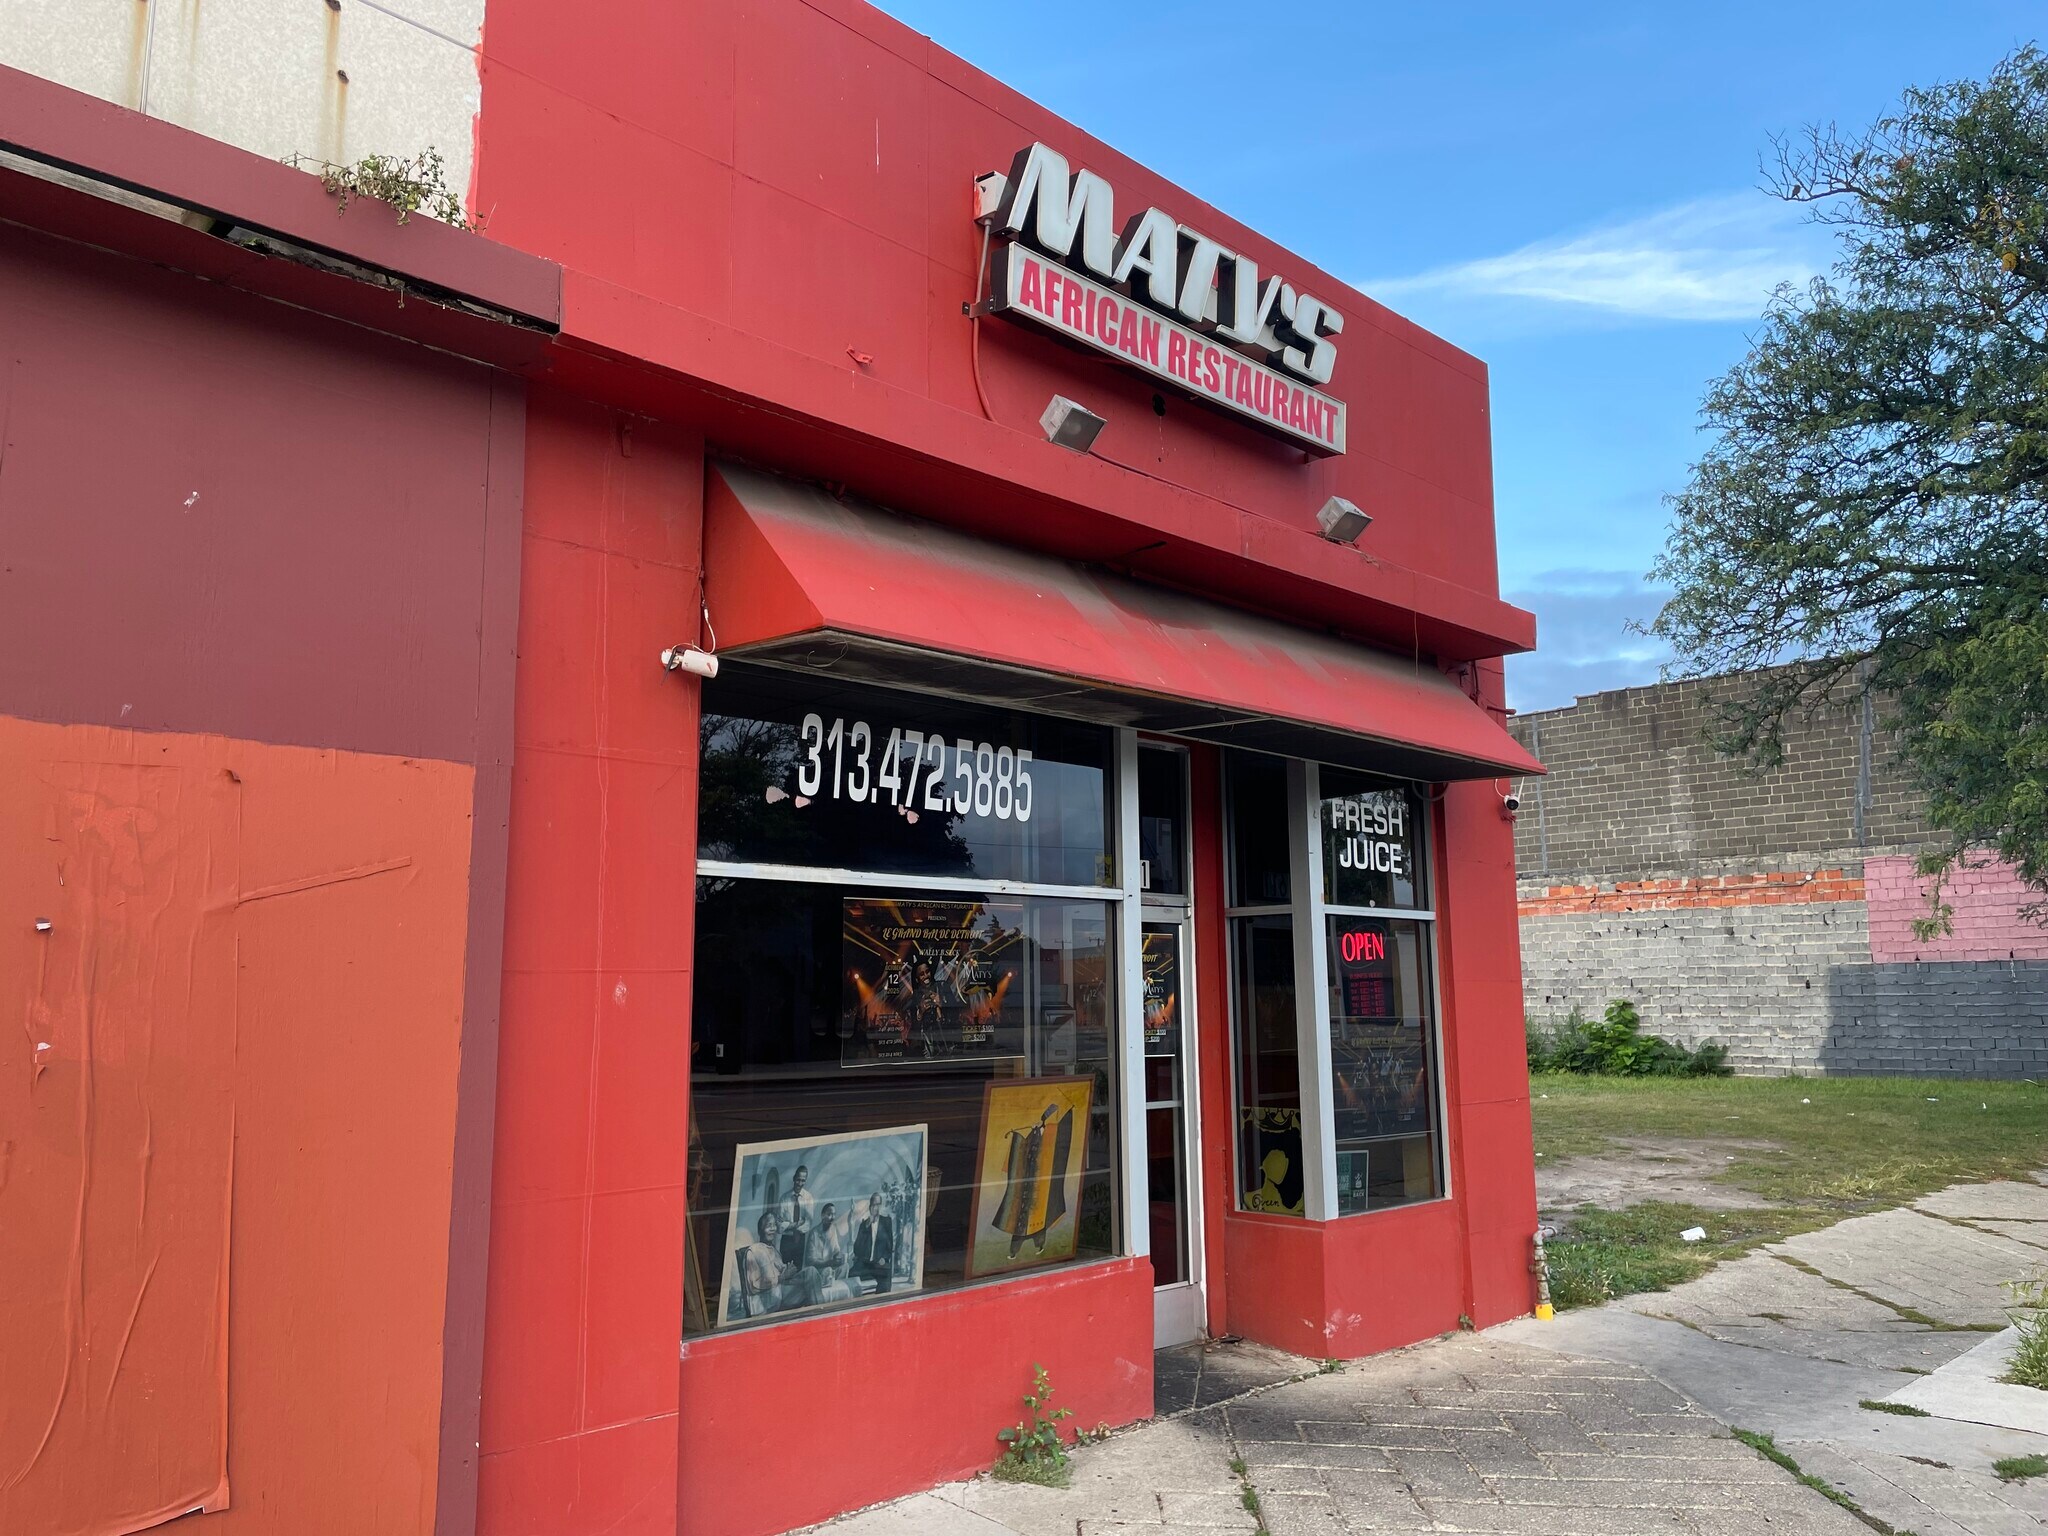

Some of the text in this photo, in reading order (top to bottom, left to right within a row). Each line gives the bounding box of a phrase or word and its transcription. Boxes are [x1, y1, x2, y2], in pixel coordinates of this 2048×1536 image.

[1004, 141, 1344, 385] MATY'S
[1019, 258, 1339, 444] AFRICAN RESTAURANT
[798, 713, 1033, 823] 313.472.5885
[1331, 799, 1404, 837] FRESH
[1339, 837, 1403, 874] JUICE
[891, 927, 922, 940] GRAND
[922, 928, 940, 942] BAL
[939, 928, 950, 939] DE
[950, 929, 984, 940] DETROIT
[1341, 932, 1384, 962] OPEN
[888, 973, 899, 984] 12
[962, 966, 992, 981] MATY'S
